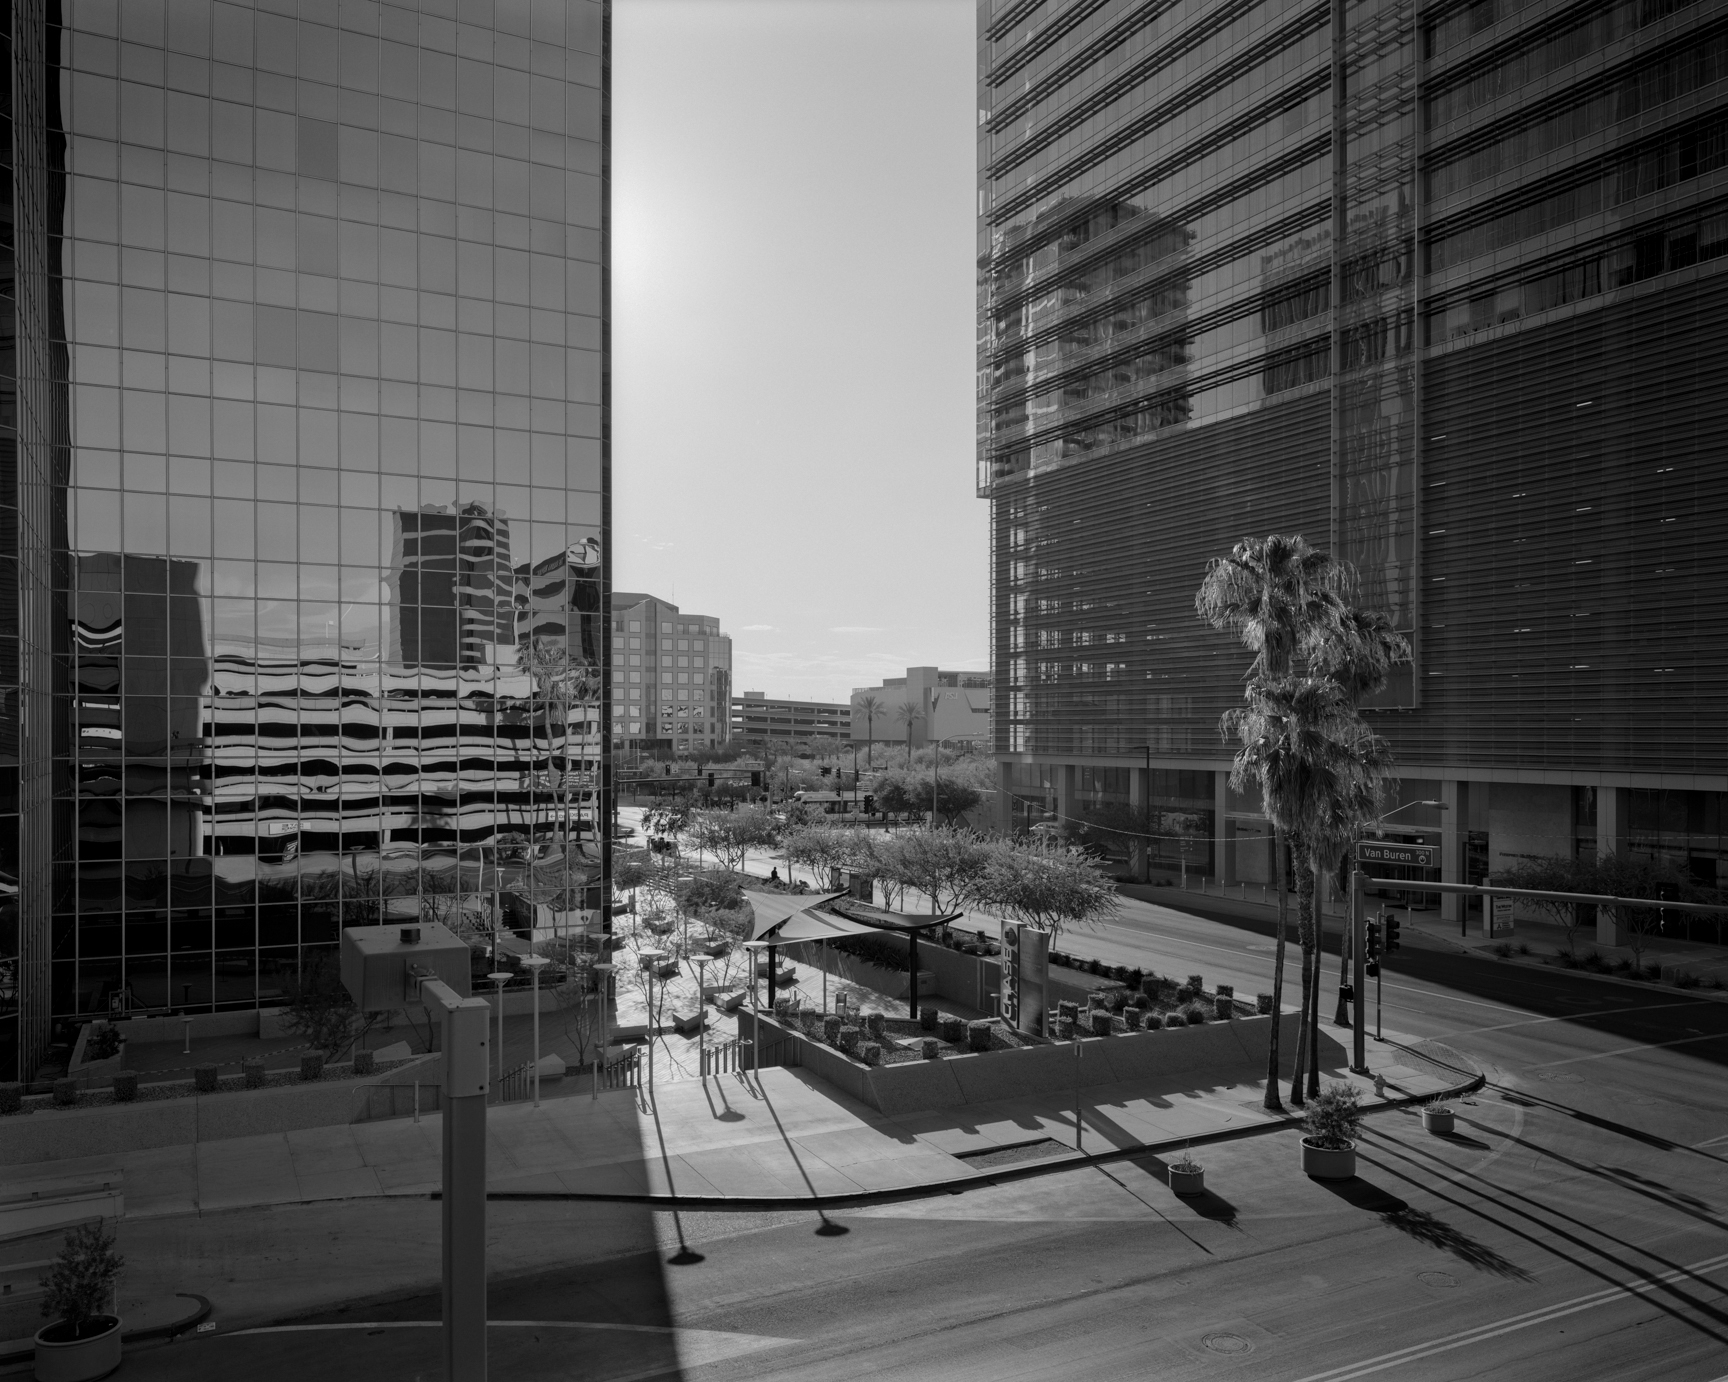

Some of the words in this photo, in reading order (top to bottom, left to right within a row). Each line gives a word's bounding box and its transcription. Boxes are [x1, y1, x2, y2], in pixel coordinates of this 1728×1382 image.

[1364, 847, 1381, 858] Van
[1383, 849, 1411, 861] Buren
[1002, 947, 1012, 1019] CHASE
